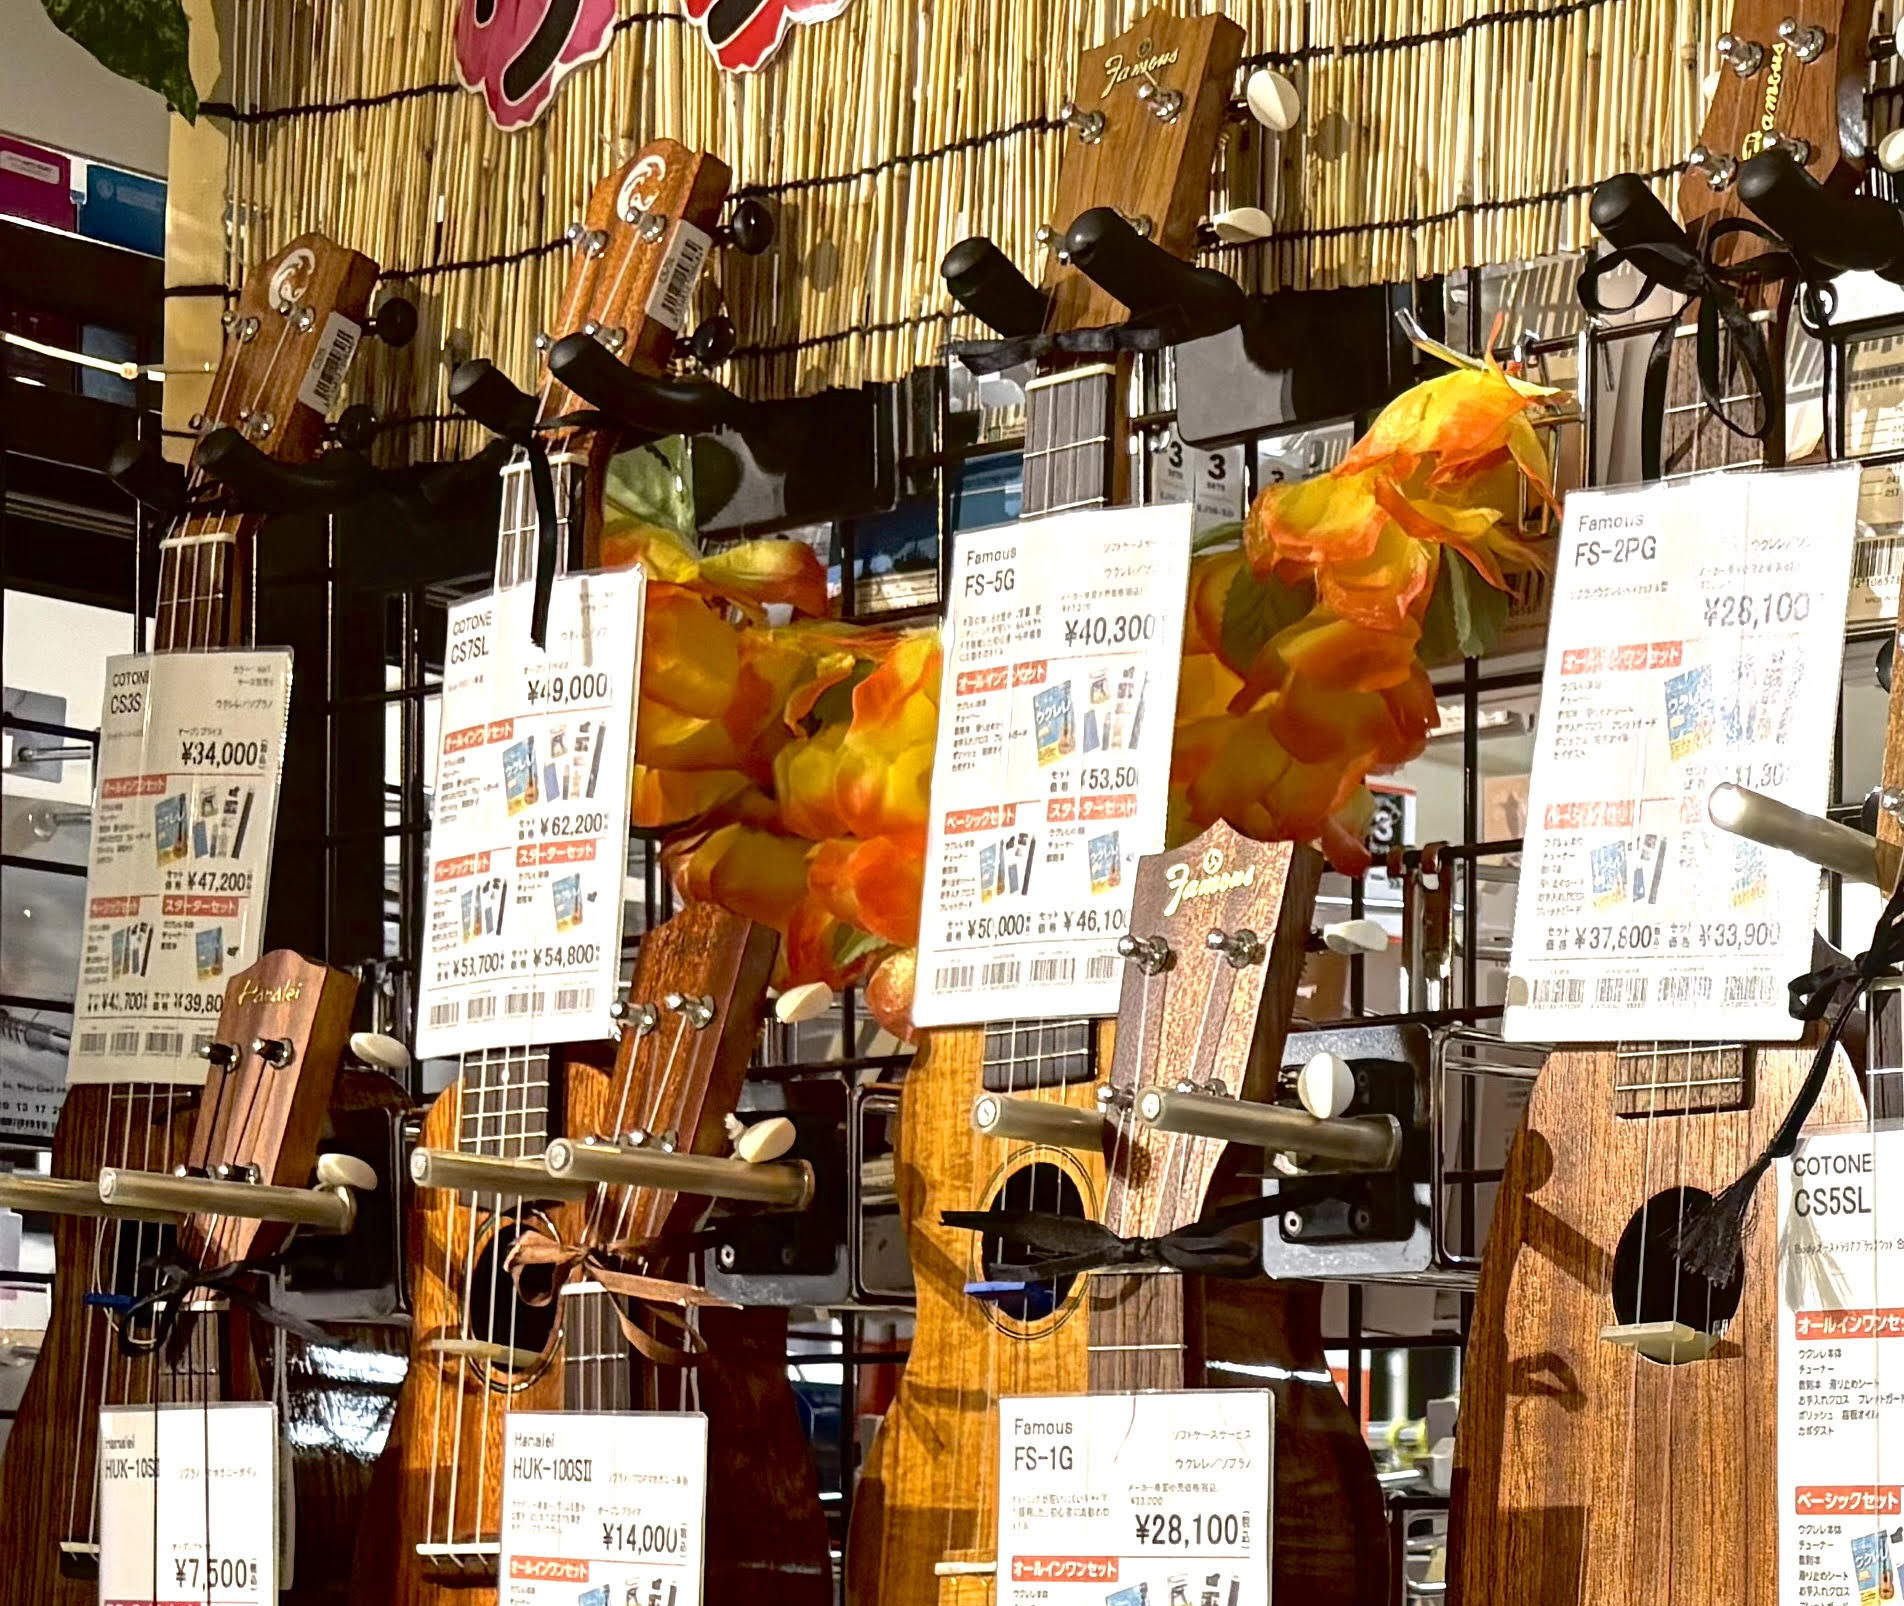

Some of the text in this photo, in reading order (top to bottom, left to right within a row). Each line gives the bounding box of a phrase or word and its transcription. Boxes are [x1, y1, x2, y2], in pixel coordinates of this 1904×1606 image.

[1101, 47, 1180, 99] Famous
[1169, 441, 1183, 468] 3
[1208, 454, 1226, 480] 3
[1579, 514, 1644, 533] Famous
[966, 547, 1017, 566] Famous
[1574, 534, 1657, 568] FS-2PG
[964, 568, 1015, 598] FS-5G
[453, 609, 493, 636] COTONE
[1064, 613, 1155, 647] ¥40,300
[450, 635, 489, 666] CS7SL
[181, 740, 259, 768] ¥34,000
[540, 811, 603, 837] ¥62,200
[187, 872, 247, 892] ¥47,200
[1163, 863, 1256, 917] Famous
[163, 898, 238, 916] スターターセット
[1574, 921, 1653, 952] ¥37,800
[533, 943, 596, 968] ¥54,800
[238, 979, 302, 1006] Hanalei
[1793, 1151, 1874, 1178] COTONE
[1793, 1185, 1873, 1218] CS5SL
[514, 1431, 556, 1449] Hanalei
[1014, 1416, 1074, 1437] Famous
[1014, 1445, 1074, 1473] FS-1G
[1797, 1489, 1899, 1512] ベーシックセット
[601, 1521, 678, 1555] ¥14,000
[1135, 1512, 1239, 1549] ¥28,100
[174, 1557, 248, 1590] ¥7,500
[1012, 1558, 1117, 1580] オールインワンセット
